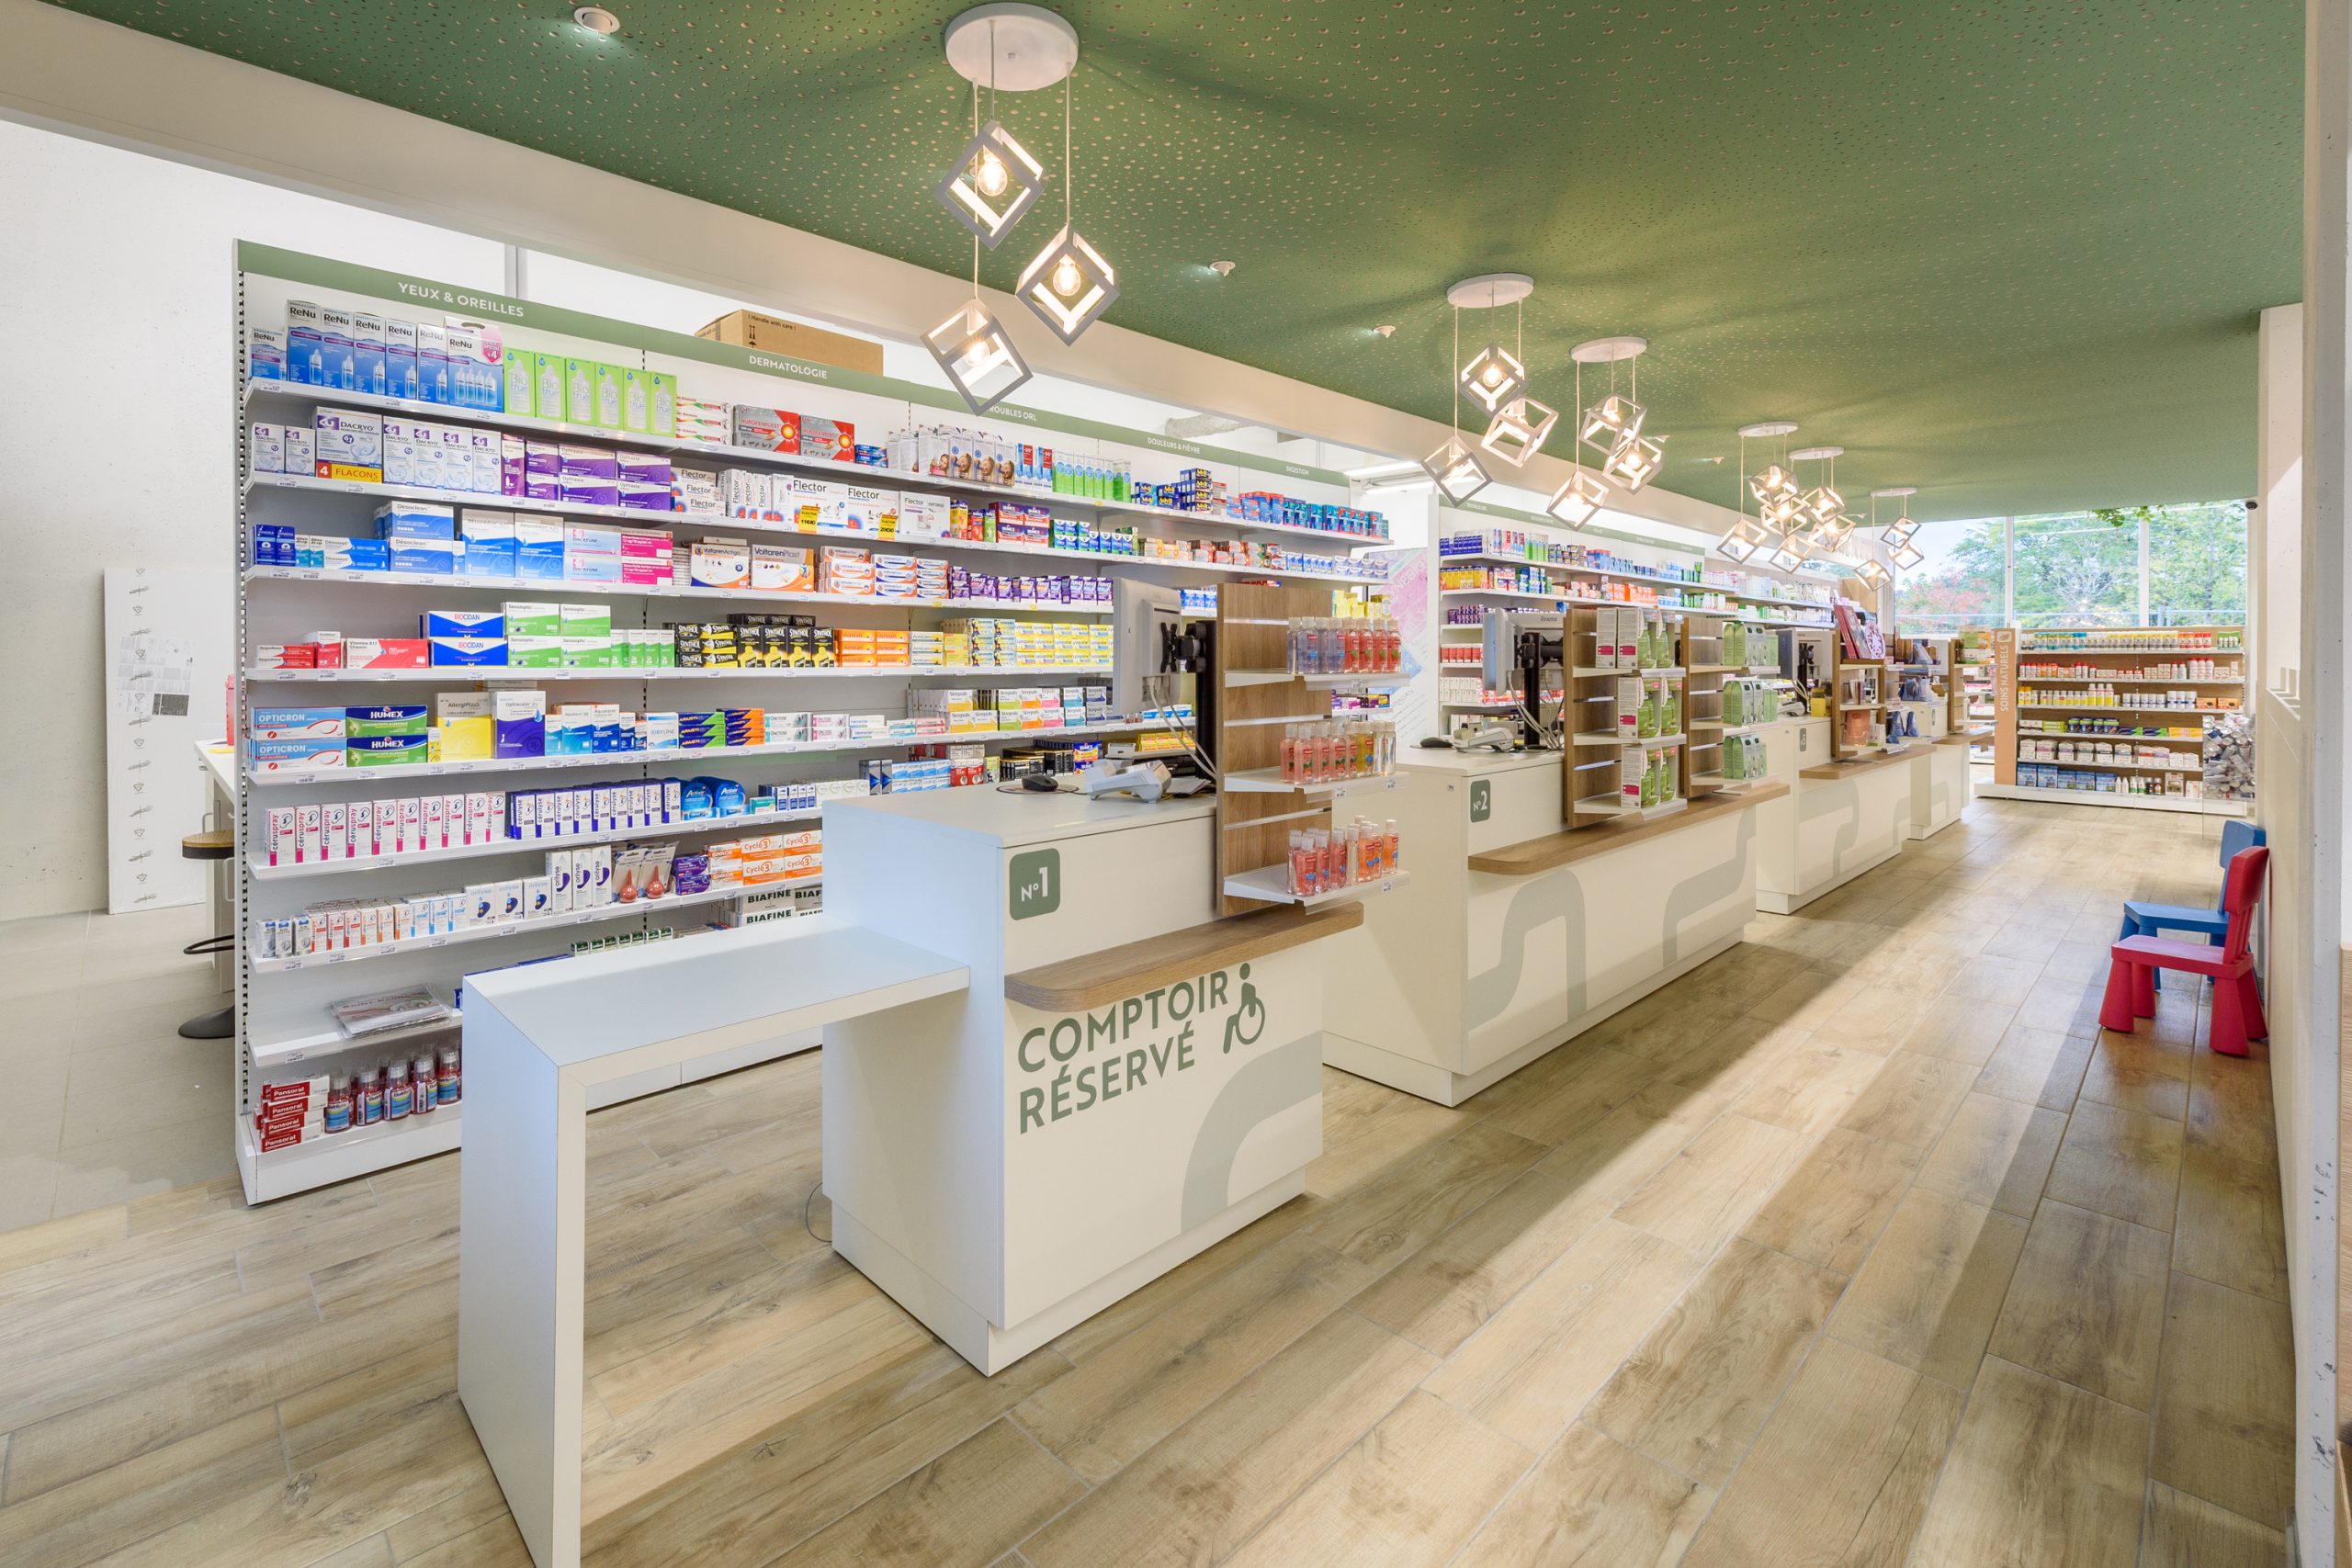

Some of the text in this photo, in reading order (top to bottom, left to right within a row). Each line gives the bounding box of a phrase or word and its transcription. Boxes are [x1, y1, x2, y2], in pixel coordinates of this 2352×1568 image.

[398, 281, 525, 317] YEUX & OREILLES
[290, 307, 316, 319] ReNu
[323, 314, 349, 325] ReNu
[751, 315, 770, 323] Handle
[356, 320, 380, 331] ReNu
[389, 325, 413, 336] ReNu
[254, 332, 275, 342] ReNu
[449, 338, 472, 349] ReNu
[749, 355, 828, 379] DERMATOLOGIE
[1023, 412, 1037, 422] ORL
[341, 421, 375, 432] DACRYO
[1148, 436, 1177, 449] DOULEURS
[320, 466, 379, 479] 4 FLACONS
[681, 469, 707, 479] Flector
[686, 484, 711, 494] Flector
[793, 479, 827, 492] Flector
[848, 488, 880, 500] Flector
[691, 498, 716, 508] Flector
[904, 497, 924, 505] Flector
[454, 613, 480, 621] BIOCIDAN
[740, 627, 760, 637] SYNTHOL
[764, 628, 785, 637] SYNTHOL
[789, 629, 808, 637] SYNTHOL
[1999, 645, 2009, 712] SOINS NATURELS
[259, 745, 306, 754] OPTICRON
[371, 740, 404, 749] HUMEX
[748, 889, 792, 904] BIAFINE
[795, 886, 821, 899] BIAF
[746, 909, 792, 924] BIAFINE
[1018, 970, 1228, 1073] COMPTOIR
[1019, 1021, 1194, 1134] RÉSERVÉ
[274, 1086, 305, 1097] Pansoral
[272, 1102, 303, 1114] Pansoral
[268, 1118, 300, 1131] Pansoral
[265, 1134, 296, 1146] Pansoral
